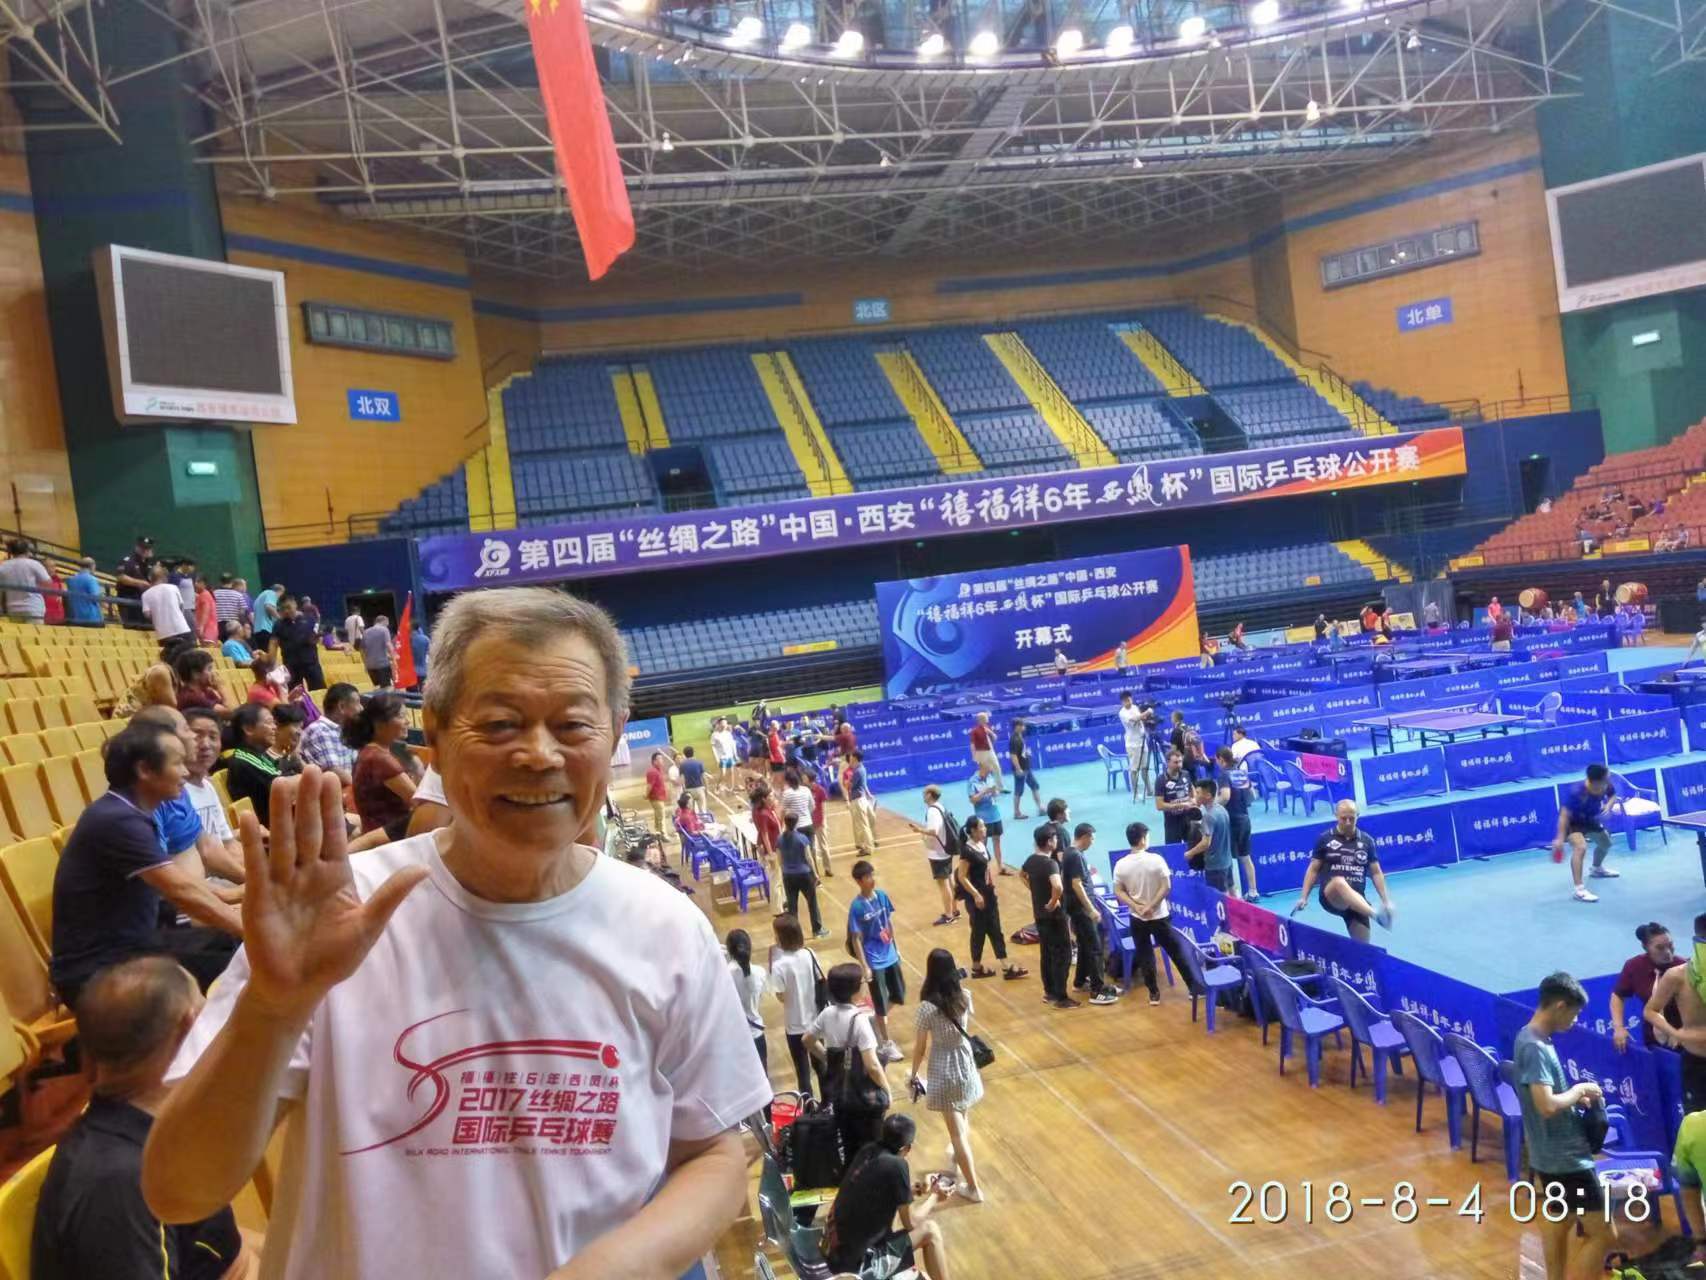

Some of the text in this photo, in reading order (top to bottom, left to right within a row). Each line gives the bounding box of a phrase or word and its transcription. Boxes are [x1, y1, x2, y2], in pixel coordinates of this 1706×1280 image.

[1407, 304, 1444, 326] 北单
[356, 396, 391, 416] 北双
[1015, 624, 1073, 650] 开幕式
[452, 1116, 618, 1145] 国际乒乓球赛
